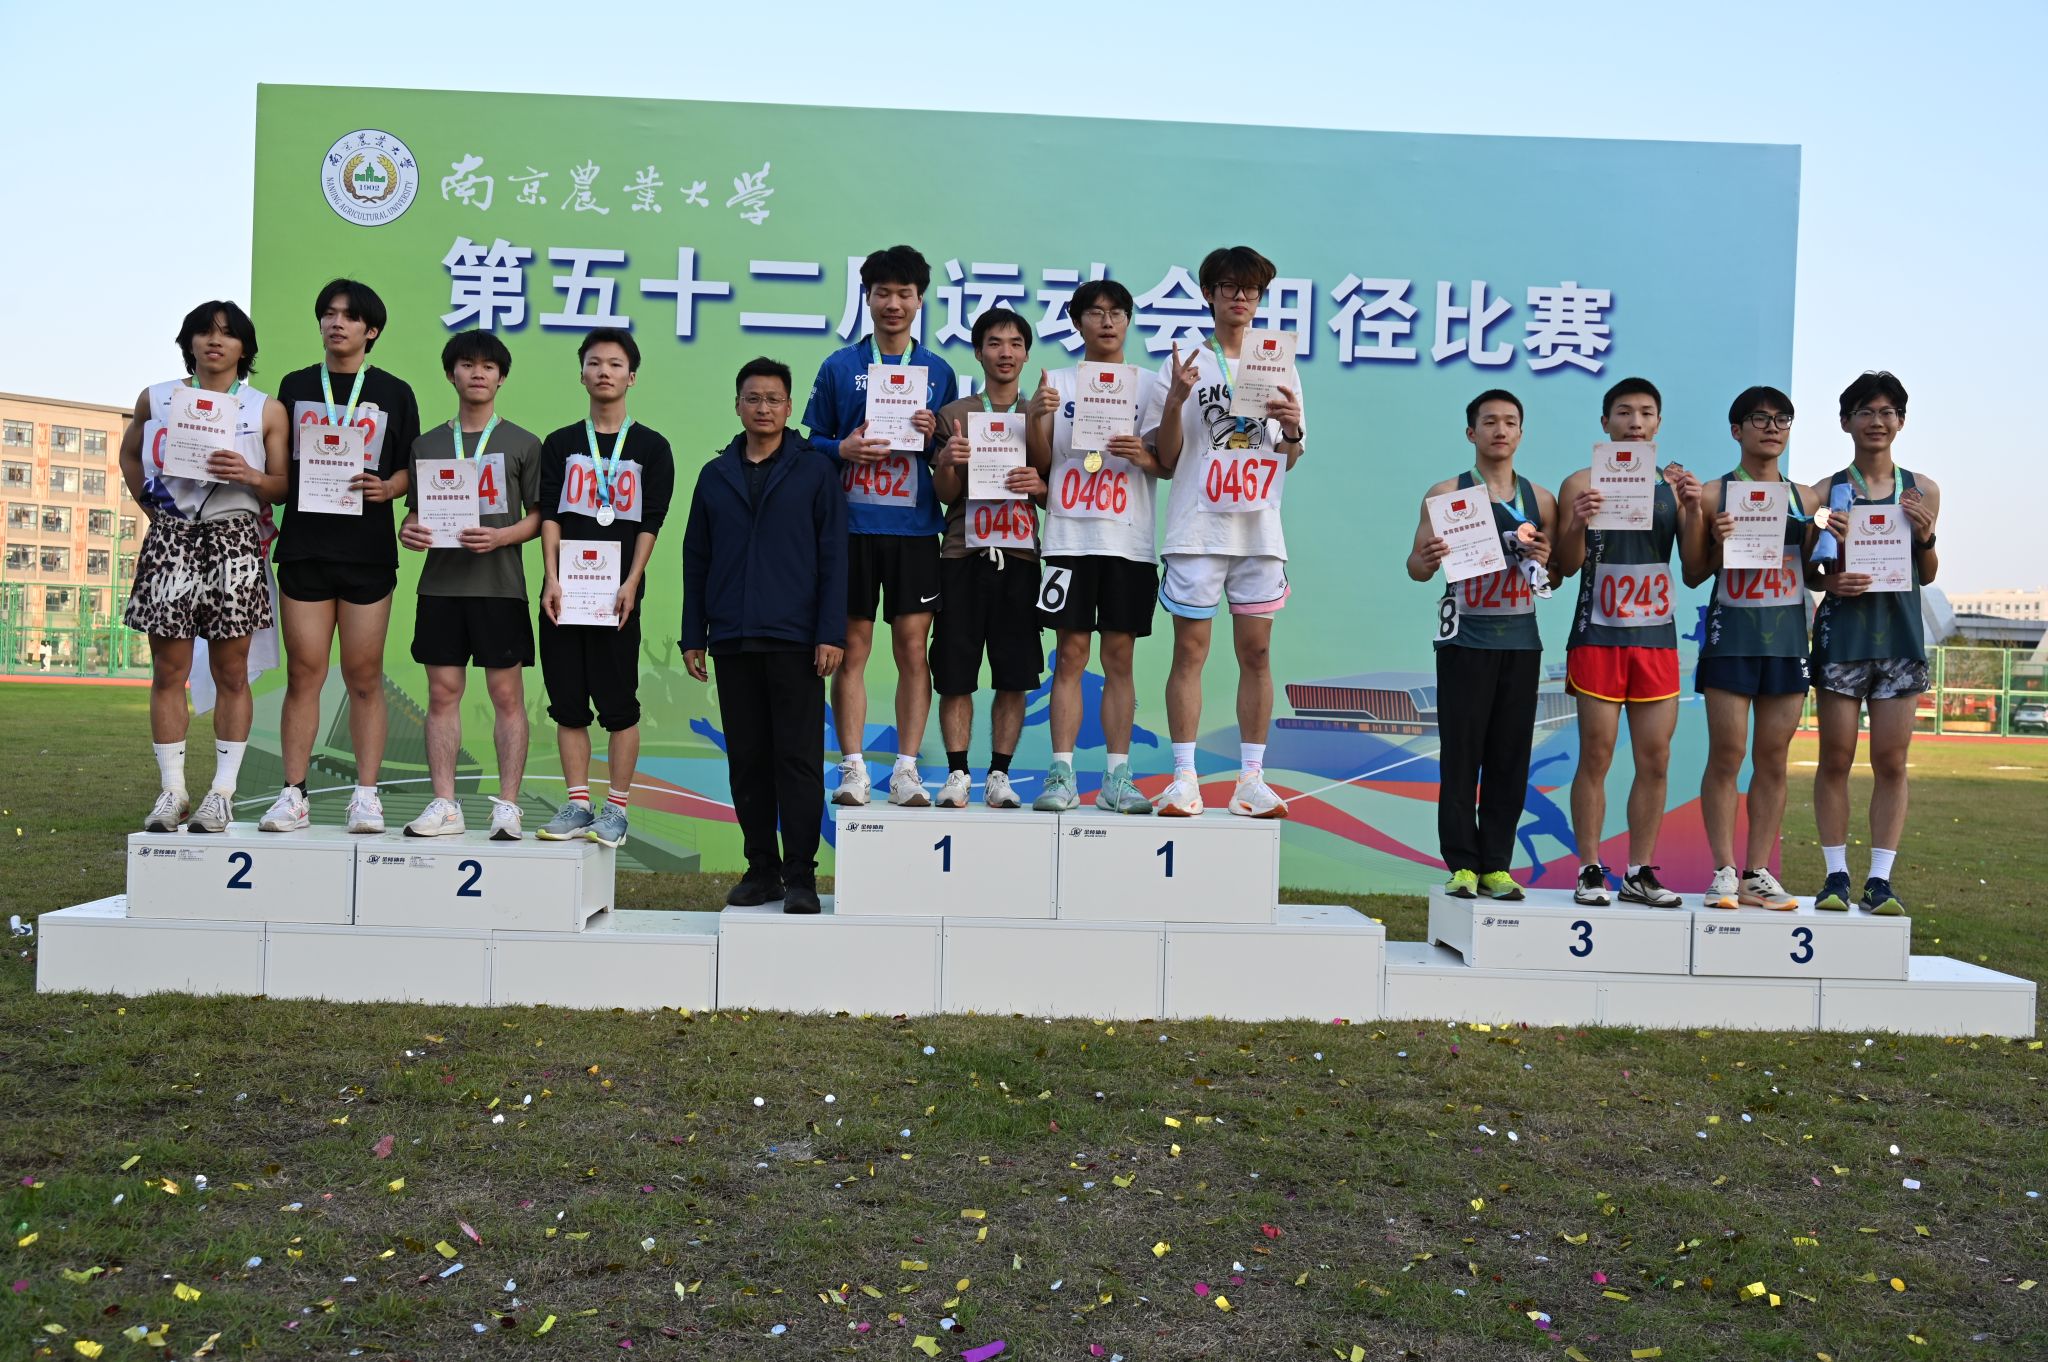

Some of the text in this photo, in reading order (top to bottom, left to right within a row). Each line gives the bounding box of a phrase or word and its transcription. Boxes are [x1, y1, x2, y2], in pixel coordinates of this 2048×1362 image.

[339, 202, 389, 222] AGRICULTURAL
[388, 180, 414, 216] UNIVERSITY
[359, 184, 380, 192] 1902
[1061, 468, 1128, 514] 0466
[1205, 458, 1279, 503] 0467
[1041, 569, 1065, 610] 6
[1464, 565, 1531, 609] 0244
[1600, 573, 1670, 618] 0243
[1726, 555, 1797, 600] 0245
[1439, 598, 1457, 638] 8
[226, 851, 253, 890] 2
[934, 835, 952, 873] 1
[1156, 840, 1174, 878] 1
[456, 859, 483, 898] 2
[1569, 919, 1594, 958] 3
[1789, 926, 1815, 965] 3
